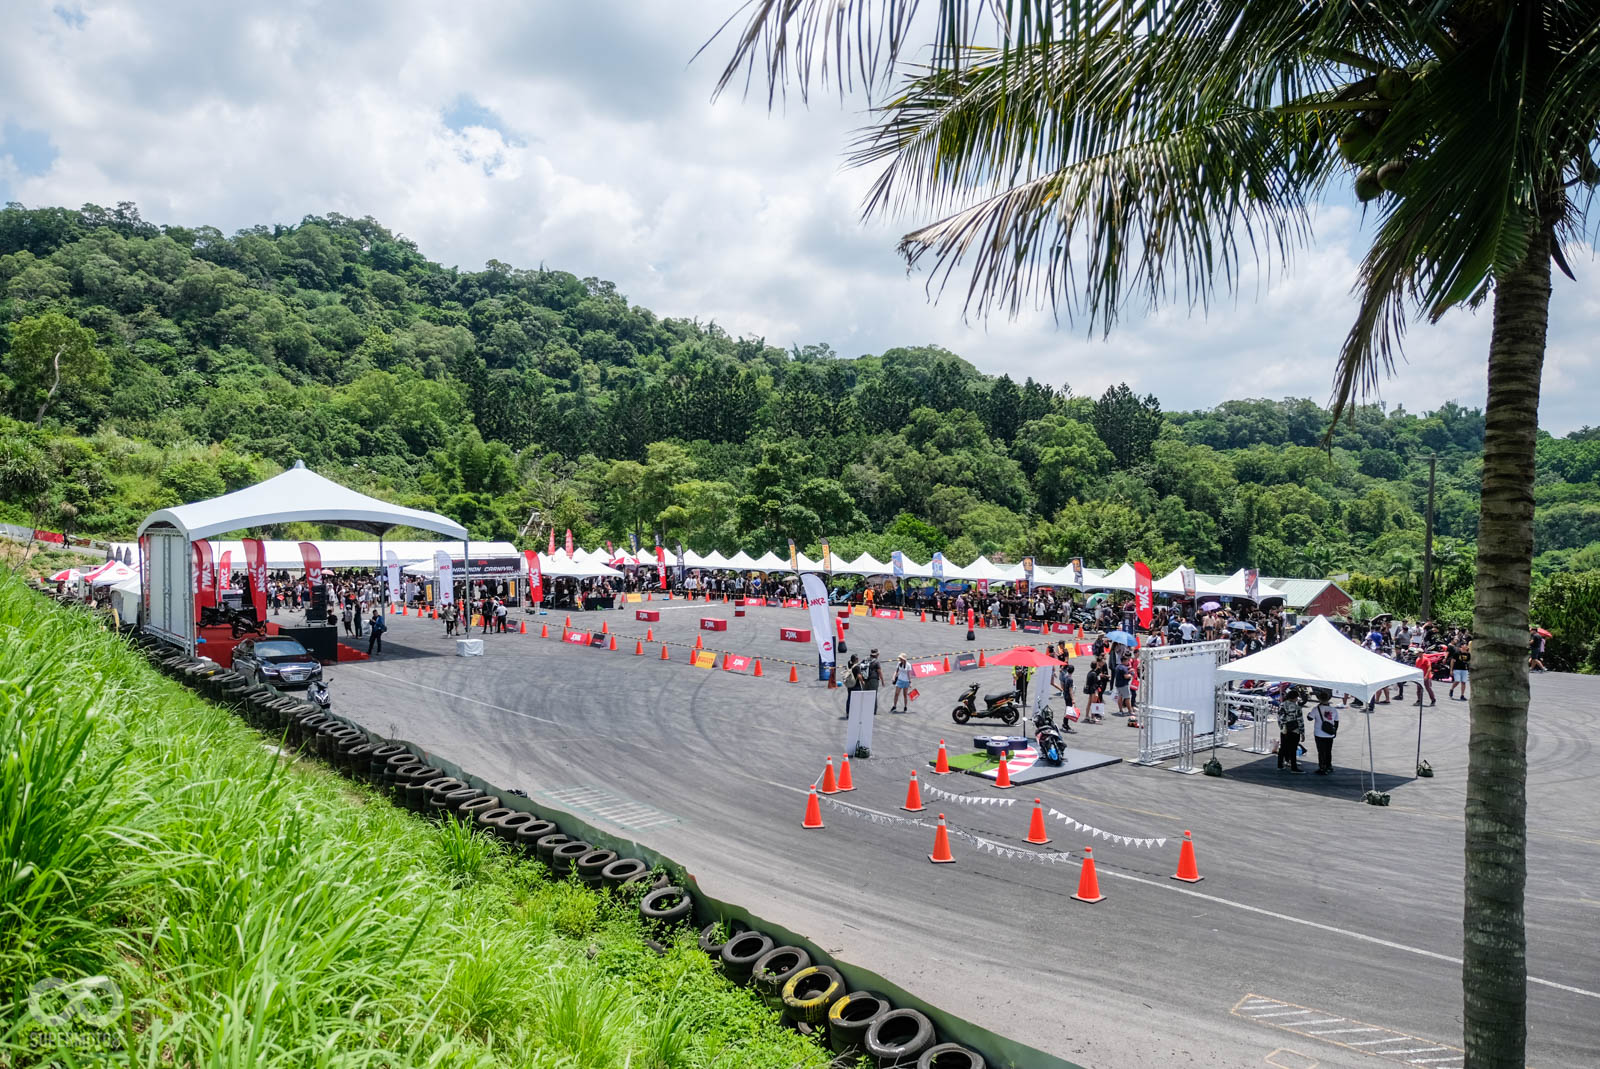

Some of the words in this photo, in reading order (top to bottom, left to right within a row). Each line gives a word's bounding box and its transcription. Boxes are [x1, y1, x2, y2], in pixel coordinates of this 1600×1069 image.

[529, 567, 541, 588] SYM
[1137, 585, 1150, 611] SYM
[784, 631, 796, 639] SYM
[920, 663, 936, 674] SYM
